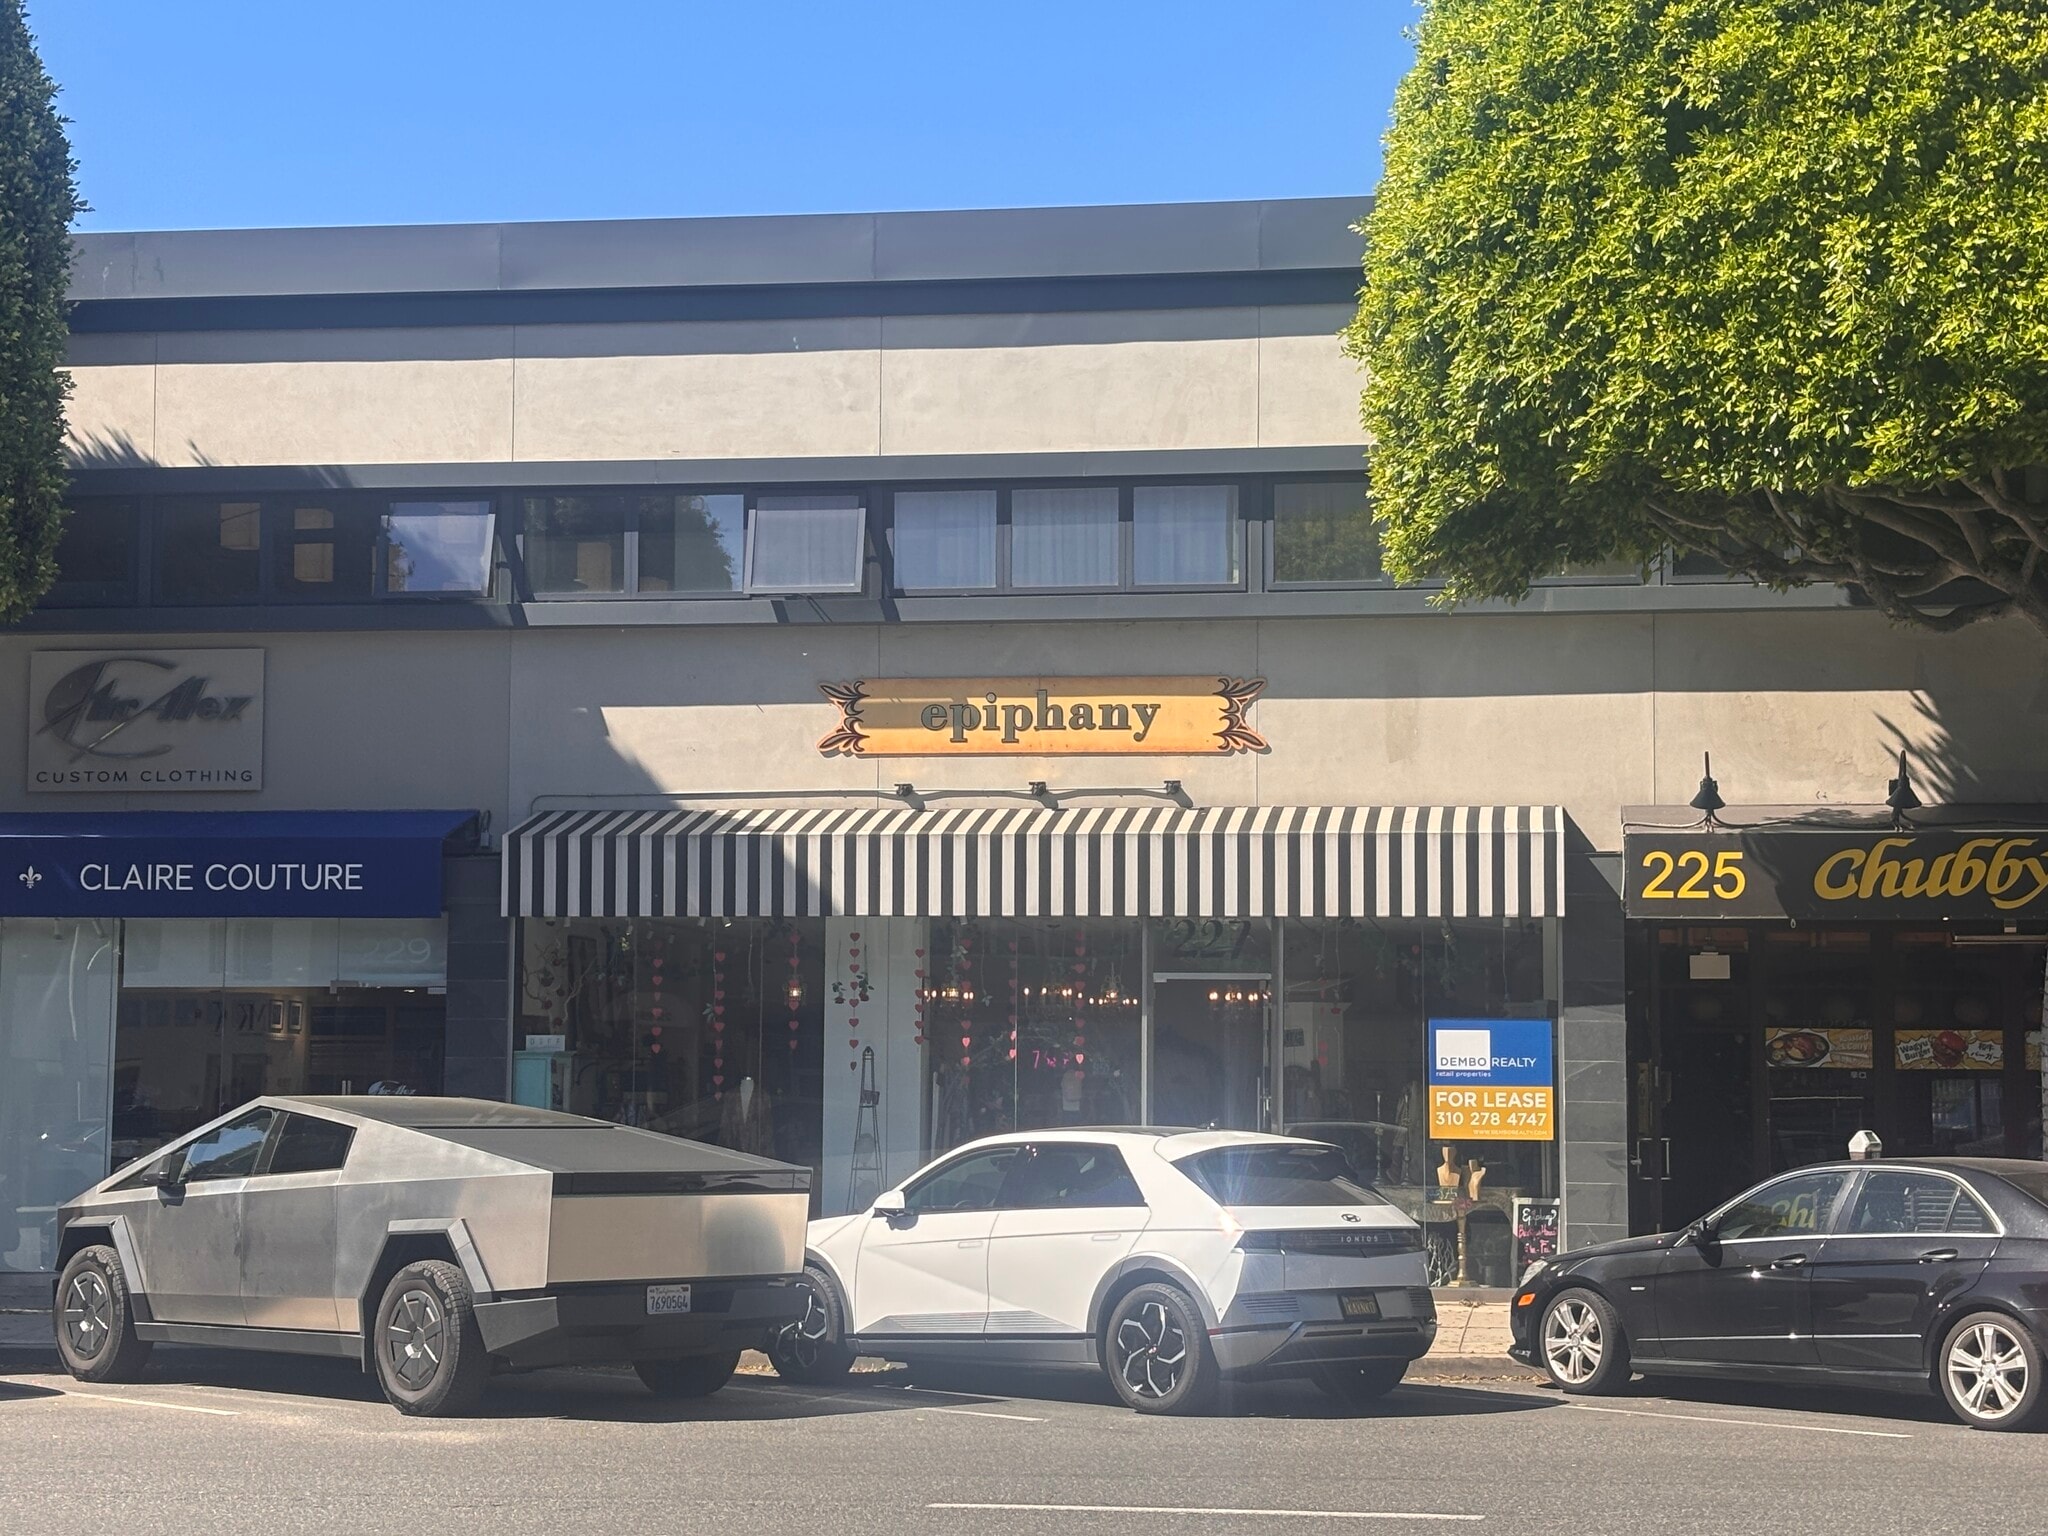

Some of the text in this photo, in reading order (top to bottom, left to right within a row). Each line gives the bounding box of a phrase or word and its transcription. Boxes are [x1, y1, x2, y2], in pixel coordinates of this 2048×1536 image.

[146, 675, 254, 722] Alex
[921, 689, 1161, 743] epiphany
[36, 769, 253, 784] CUSTOM CLOTHING
[80, 863, 363, 891] CLAIRE COUTURE
[1641, 850, 1746, 899] 225
[1173, 919, 1252, 959] 227
[1900, 1040, 1929, 1054] Wagyu
[1904, 1047, 1931, 1061] Burger
[1440, 1057, 1536, 1067] DEMBO REALTY
[1436, 1092, 1547, 1108] FOR LEASE
[1436, 1112, 1547, 1126] 310 278 4747
